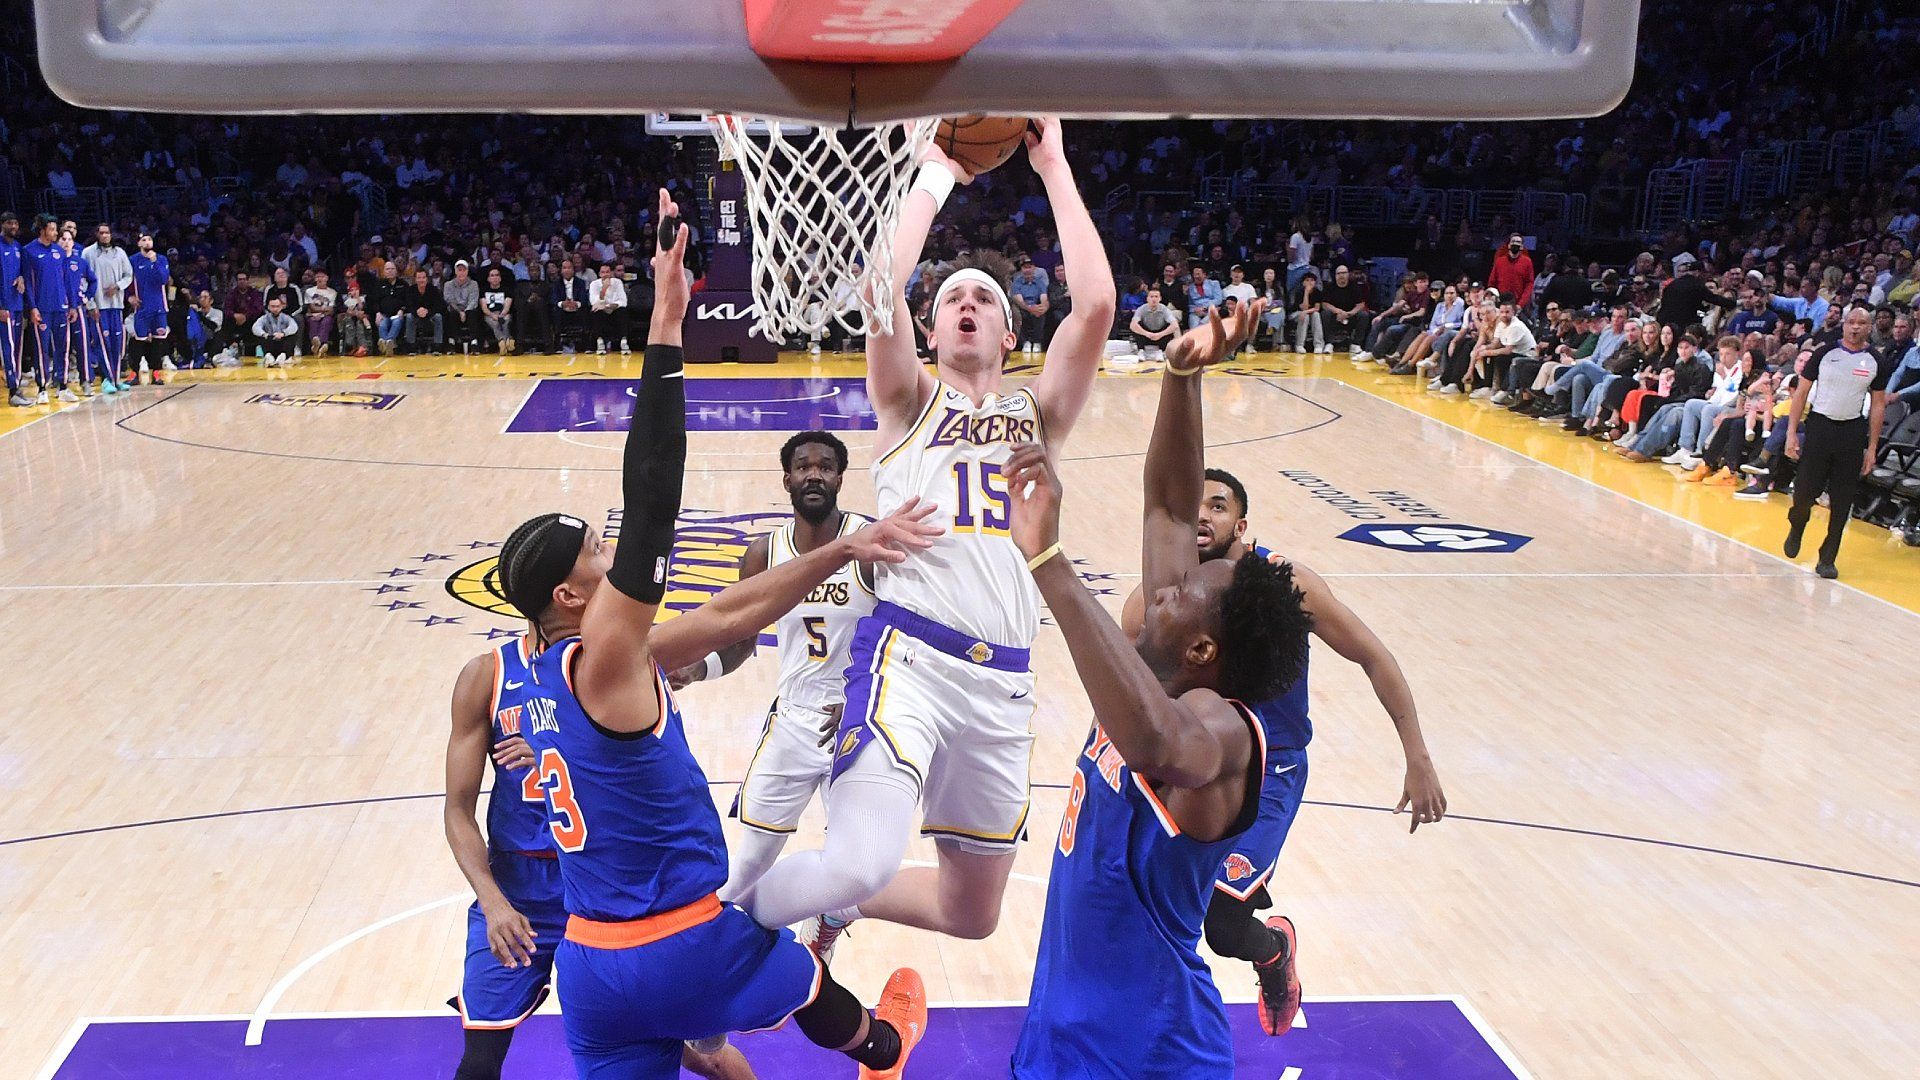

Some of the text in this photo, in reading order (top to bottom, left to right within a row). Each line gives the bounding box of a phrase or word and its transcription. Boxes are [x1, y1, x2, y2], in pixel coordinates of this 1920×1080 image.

[720, 200, 737, 214] GET
[720, 214, 738, 229] THE
[697, 303, 761, 320] KIA
[924, 406, 1035, 450] LAKERS
[952, 461, 1012, 537] 15
[1368, 490, 1451, 520] ARENA
[803, 616, 828, 661] 5
[526, 697, 561, 736] HART
[540, 748, 588, 853] 3
[1059, 765, 1086, 857] 8
